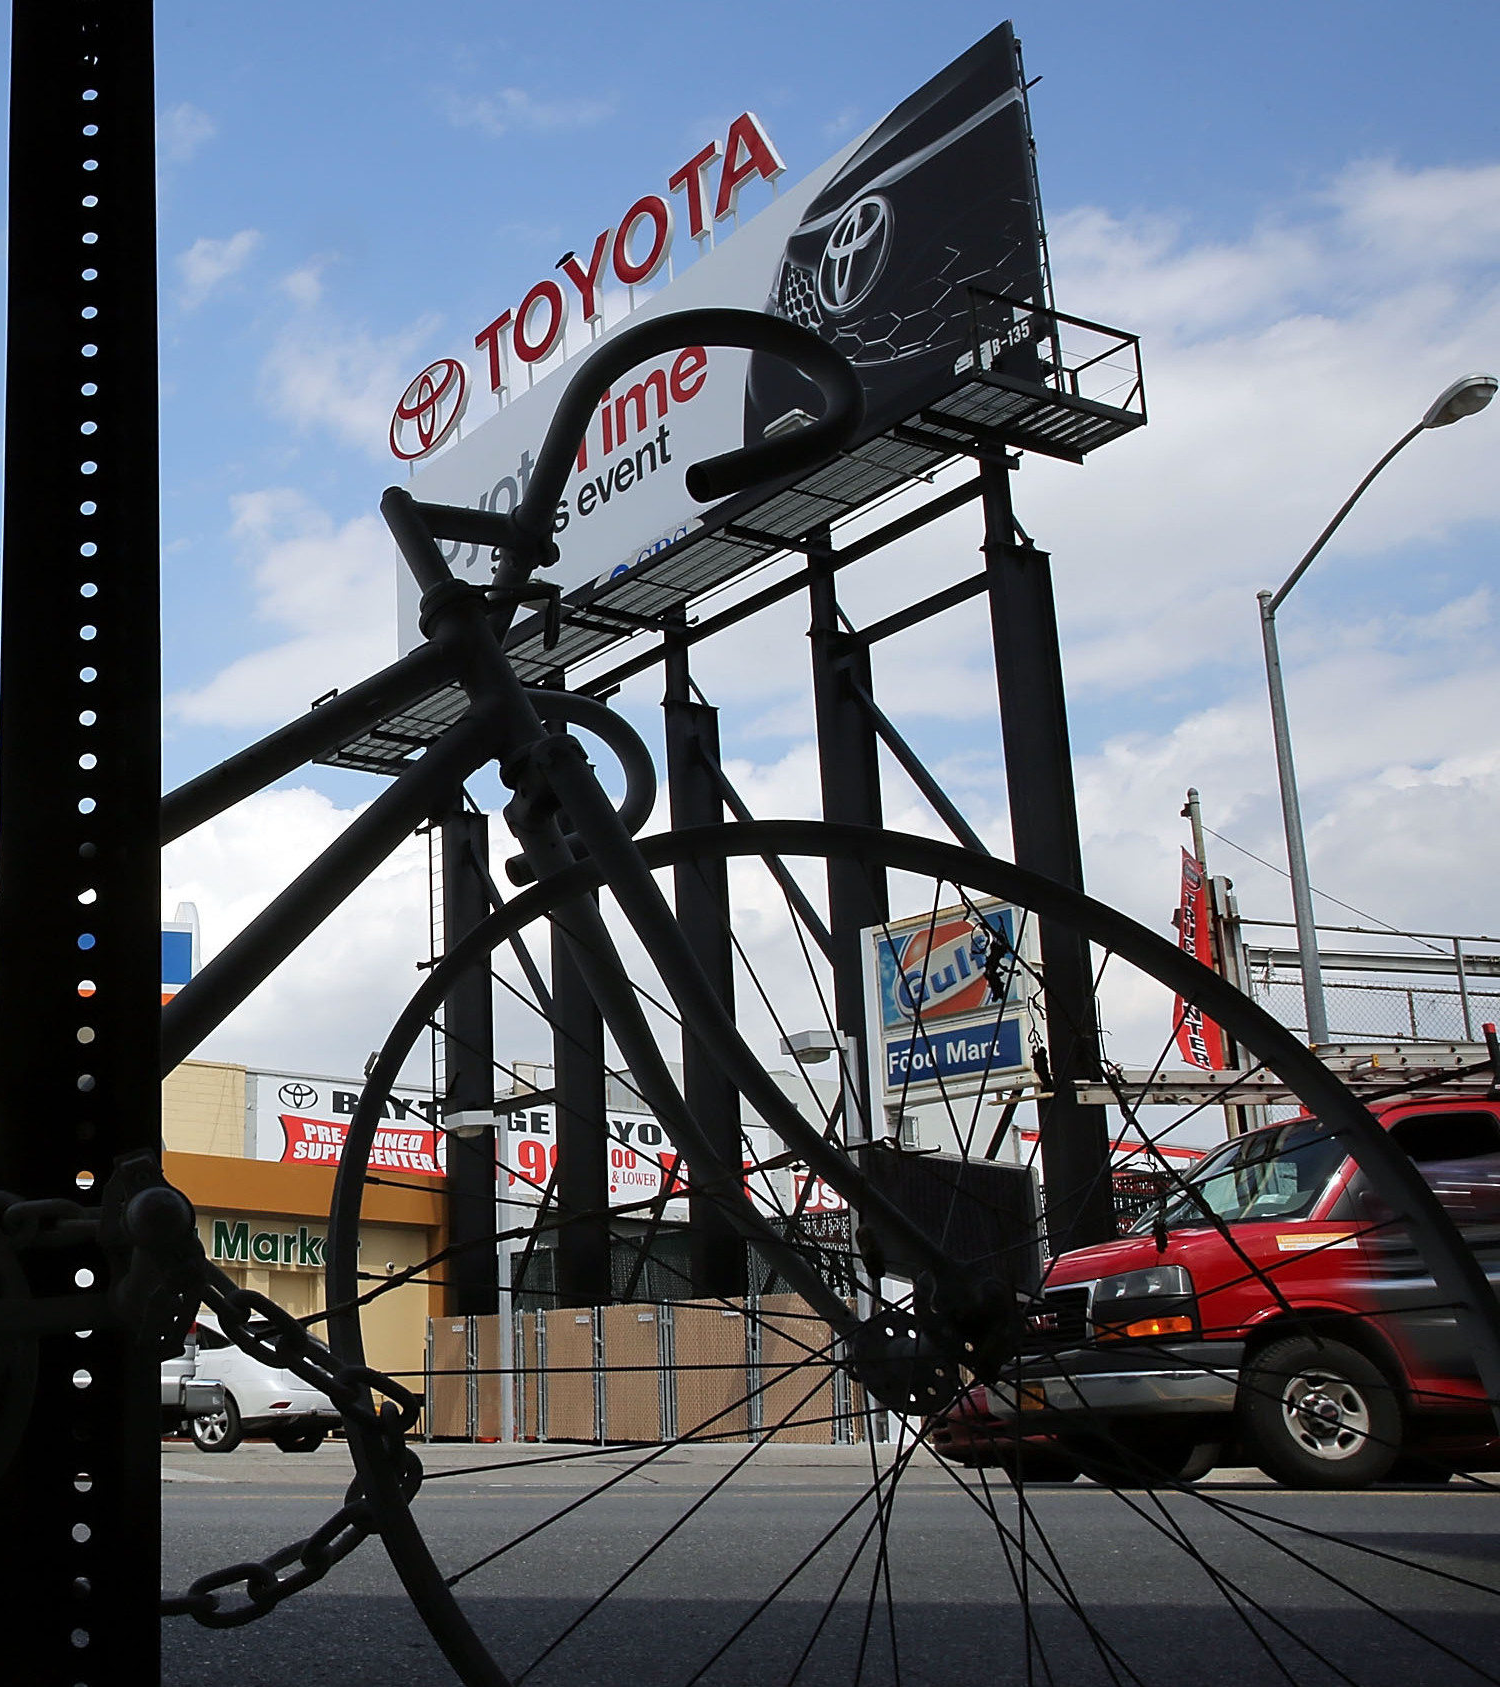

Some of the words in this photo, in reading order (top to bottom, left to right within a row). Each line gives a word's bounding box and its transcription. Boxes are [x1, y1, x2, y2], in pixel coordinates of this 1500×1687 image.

[475, 111, 787, 394] TOYOTA
[991, 319, 1031, 356] B-135
[577, 424, 672, 516] event
[1183, 890, 1198, 959] TRUC
[900, 934, 989, 1008] Gulf
[888, 1045, 937, 1075] Food
[946, 1039, 1001, 1065] Mart
[622, 1171, 657, 1187] LOWER
[213, 1219, 363, 1268] Mark
